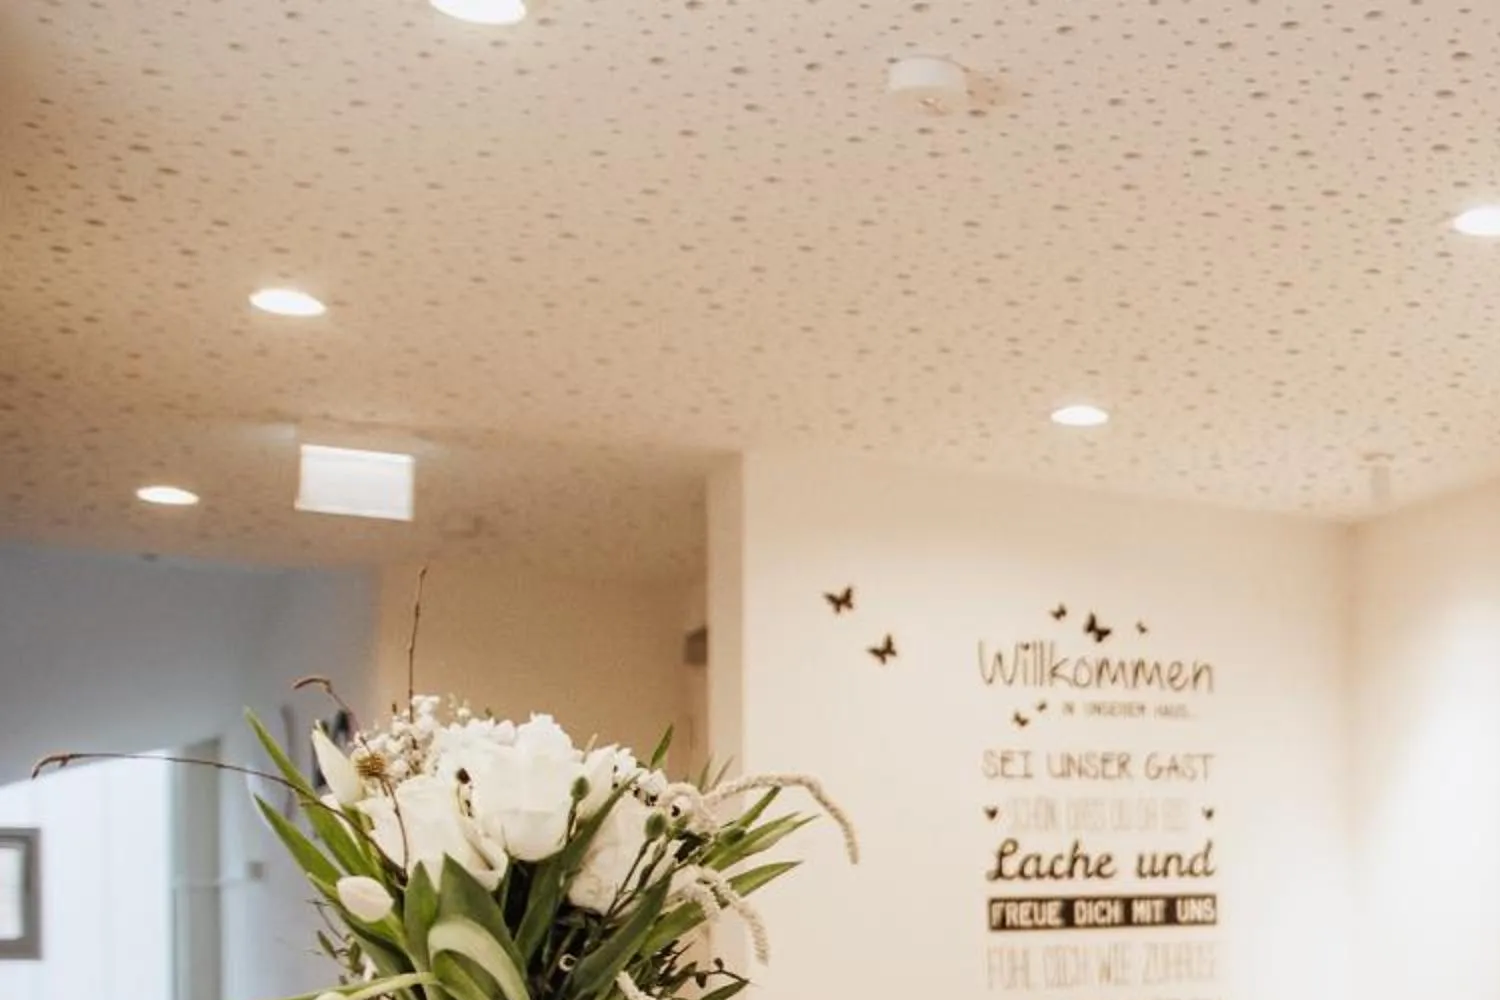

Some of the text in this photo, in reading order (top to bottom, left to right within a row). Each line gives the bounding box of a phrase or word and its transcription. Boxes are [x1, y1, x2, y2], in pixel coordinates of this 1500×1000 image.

[977, 638, 1215, 693] Willkommen
[981, 749, 1216, 782] SEI UNSER GAST
[985, 837, 1216, 882] Lache und
[990, 896, 1215, 928] FREUE DICH MIT UNS
